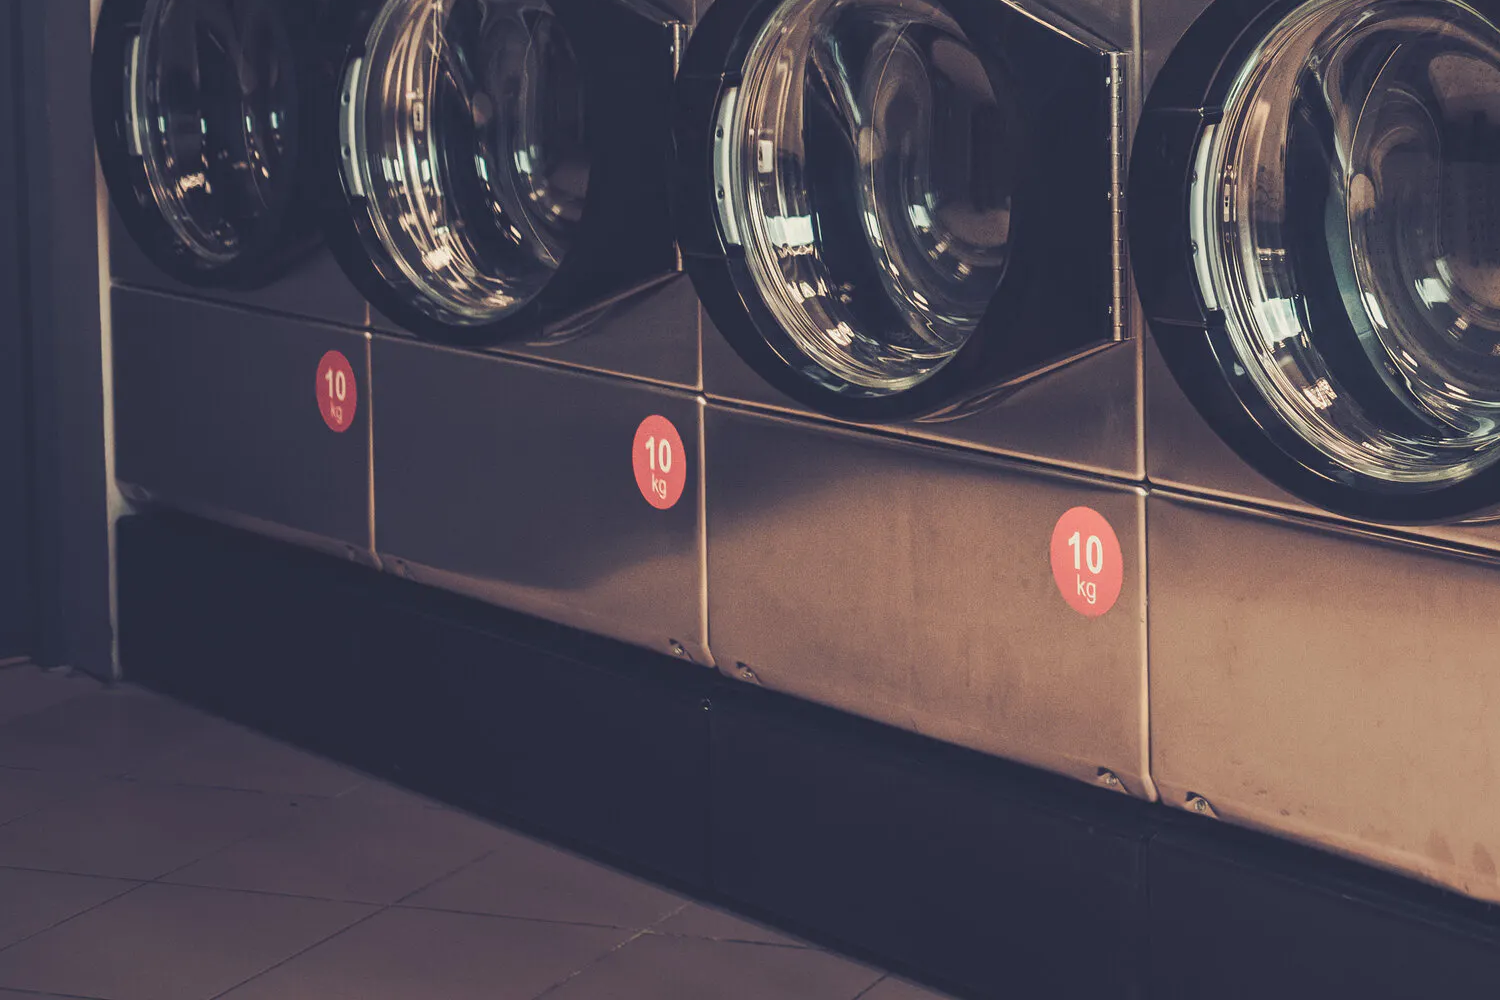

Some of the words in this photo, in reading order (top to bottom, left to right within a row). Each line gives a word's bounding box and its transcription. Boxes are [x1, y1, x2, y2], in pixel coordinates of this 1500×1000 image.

[325, 367, 346, 401] 10
[645, 436, 671, 473] 10
[652, 473, 666, 499] kg
[1068, 532, 1103, 574] 10
[1077, 574, 1096, 604] kg
